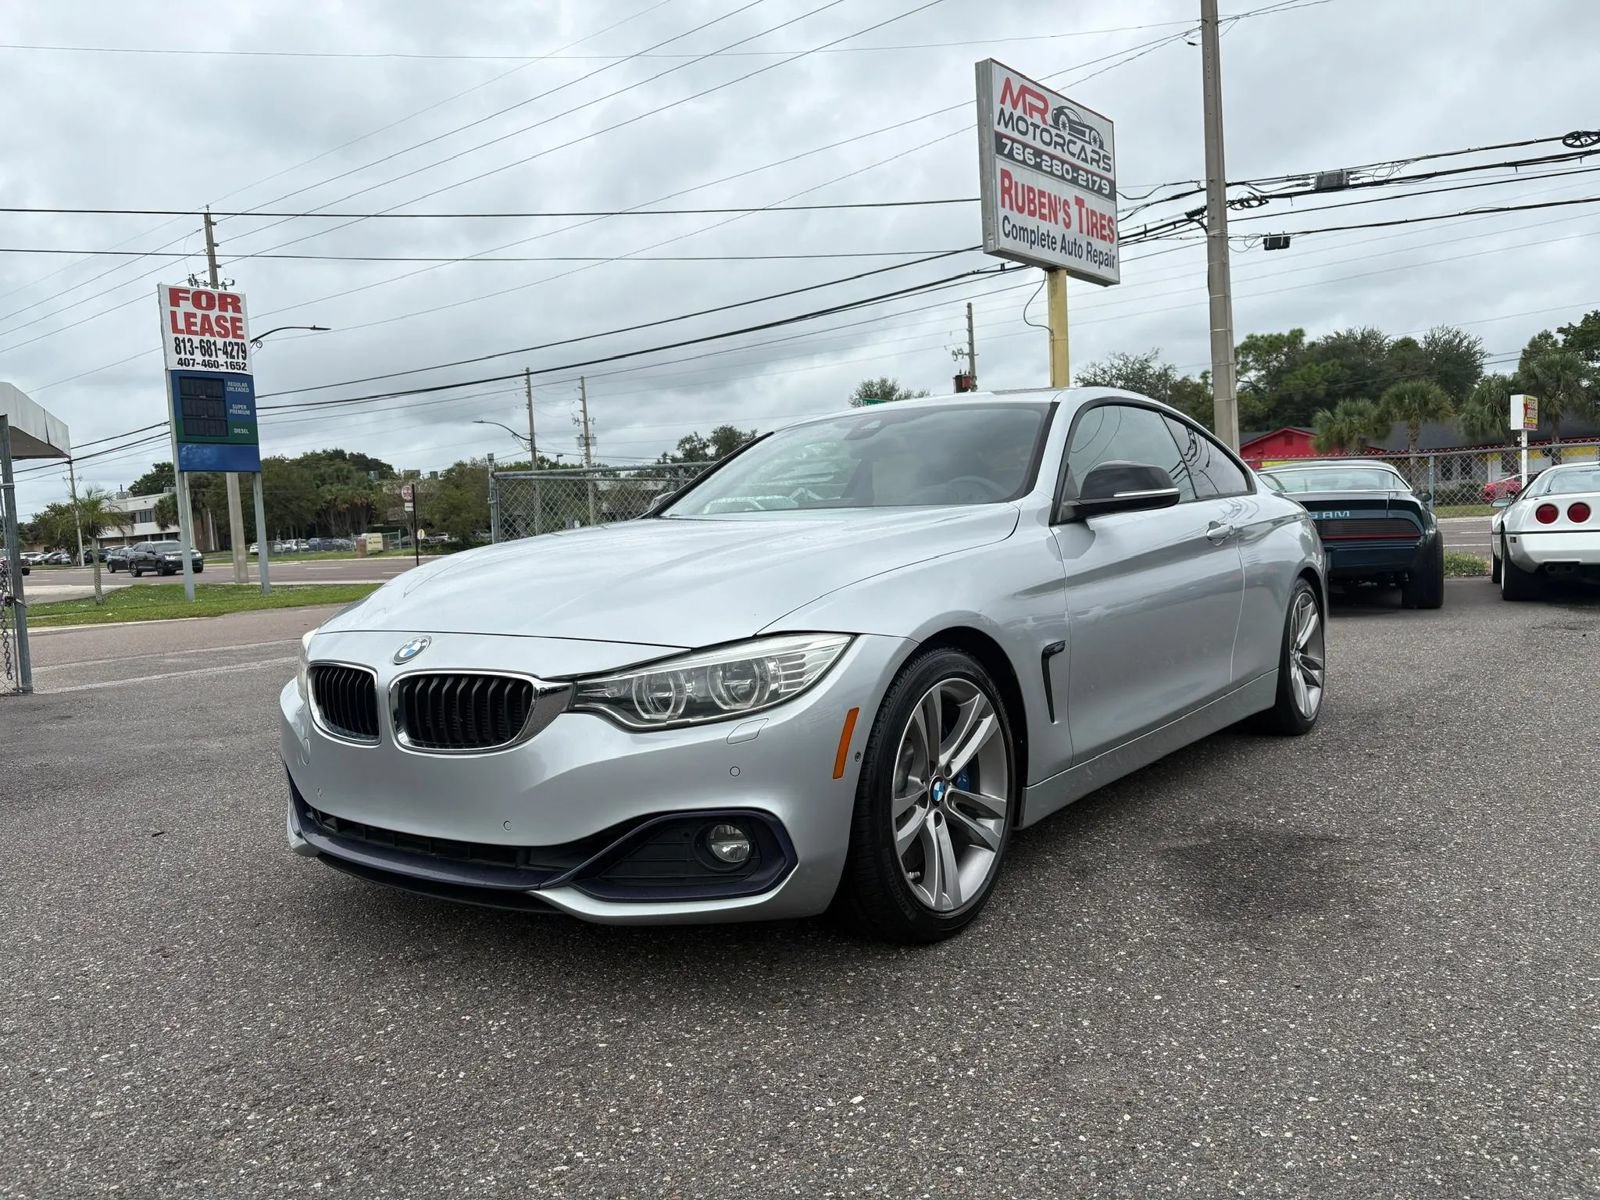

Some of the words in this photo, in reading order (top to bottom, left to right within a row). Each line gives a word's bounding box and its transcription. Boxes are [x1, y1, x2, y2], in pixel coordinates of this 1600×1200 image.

[1000, 77, 1049, 126] MR
[997, 107, 1112, 174] MOTORCARS
[1001, 137, 1111, 196] 786-280-2179
[1000, 168, 1072, 230] RUBEN'S
[1074, 194, 1116, 244] TIRES
[1002, 214, 1058, 251] Complete
[1059, 233, 1084, 260] Auto
[1086, 241, 1116, 270] Repair
[168, 287, 243, 314] FOR
[170, 310, 245, 340] LEASE
[174, 336, 248, 361] 813-681-4279
[177, 357, 248, 372] 407-460-1652
